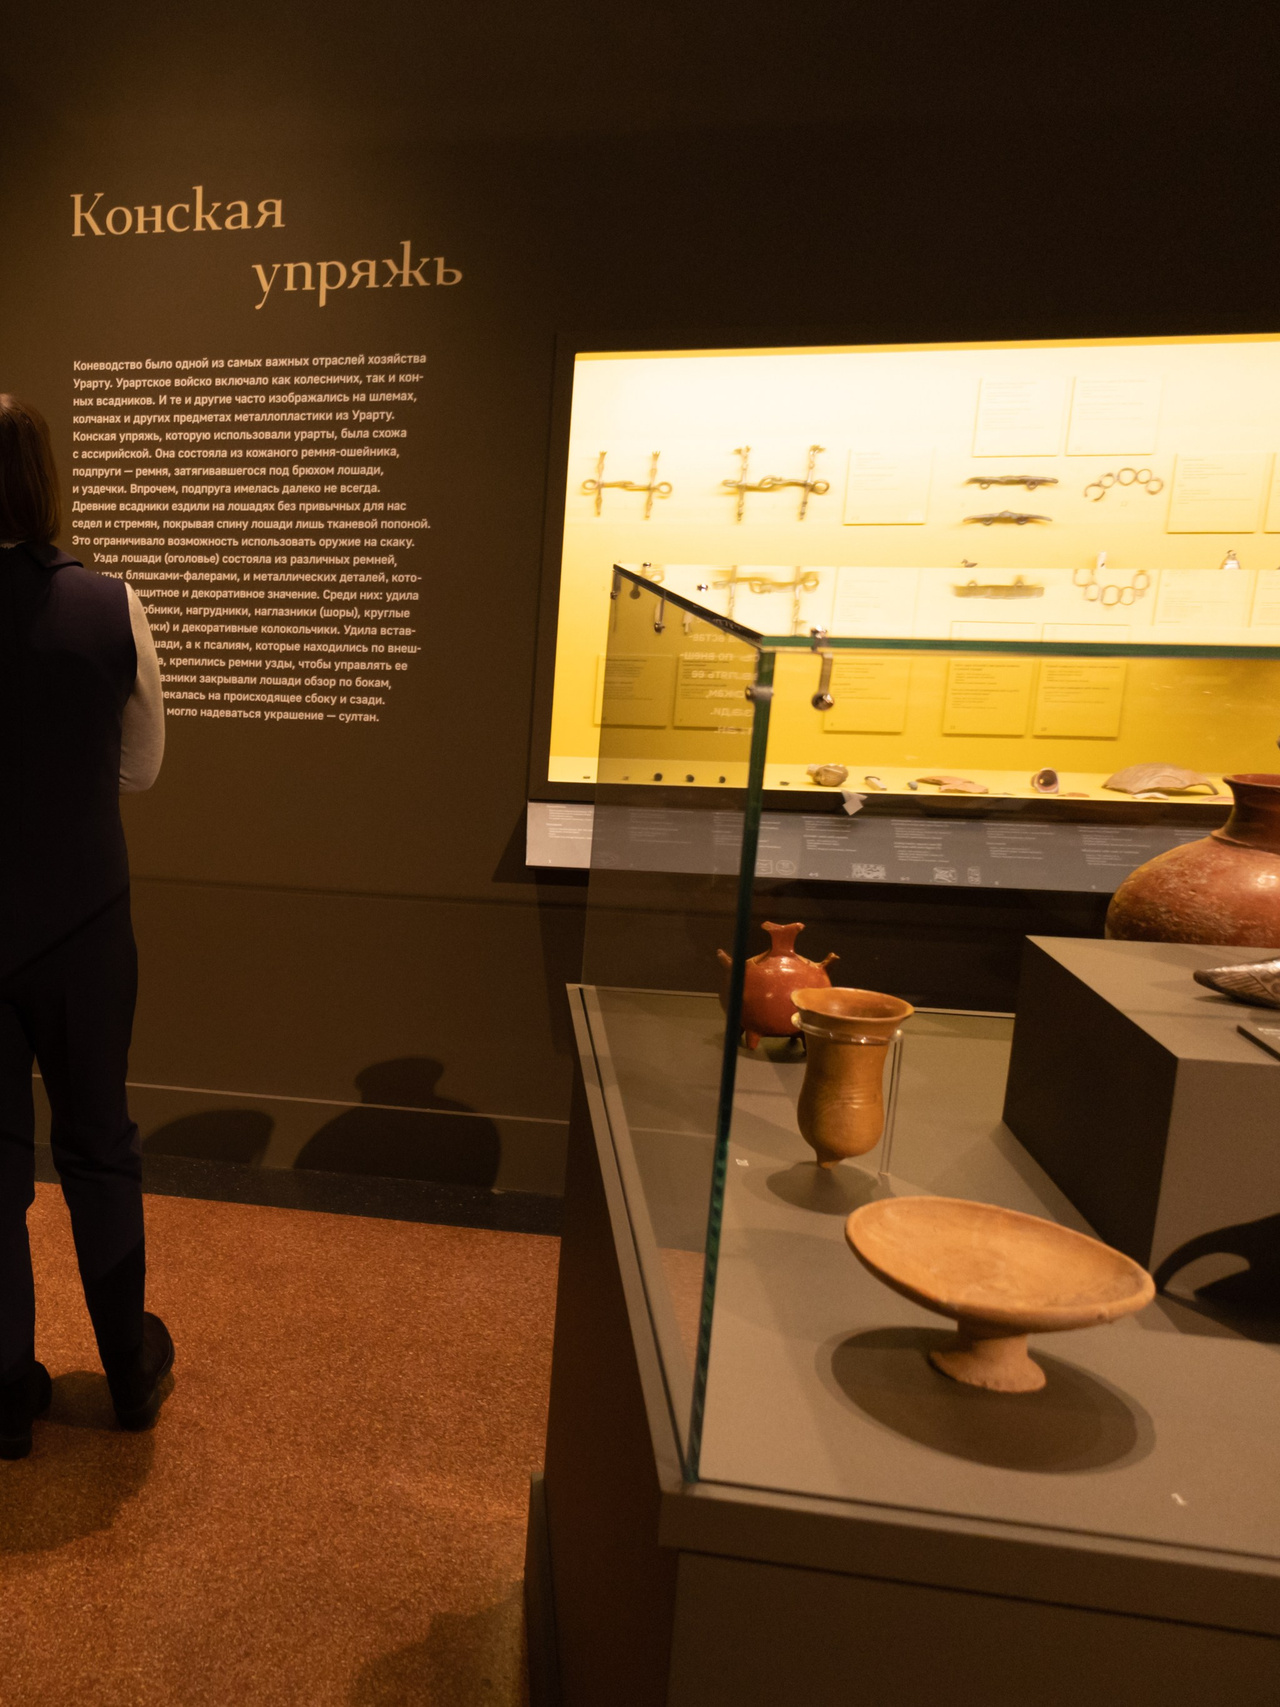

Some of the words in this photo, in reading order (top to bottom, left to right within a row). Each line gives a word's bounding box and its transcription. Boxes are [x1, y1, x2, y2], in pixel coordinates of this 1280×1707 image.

[69, 185, 286, 237] Конская
[251, 240, 463, 310] упряжь
[73, 360, 143, 371] Коневодство
[144, 358, 173, 369] было
[174, 357, 209, 370] одной
[211, 359, 225, 368] из
[226, 358, 262, 368] самых
[265, 357, 310, 367] важных
[312, 354, 365, 368] отраслей
[367, 353, 426, 364] хозяйства
[72, 378, 113, 391] Урарту.
[115, 377, 172, 390] Урартское
[174, 375, 212, 387] войско
[214, 376, 269, 386] включало
[271, 376, 291, 385] как
[293, 375, 362, 385] колесничих,
[365, 374, 385, 383] так
[388, 374, 396, 382] и
[398, 373, 424, 382] кон-
[72, 397, 94, 406] ных
[96, 396, 156, 407] всадников.
[158, 394, 167, 405] И
[169, 396, 182, 405] те
[184, 396, 192, 404] и
[193, 395, 232, 407] другие
[234, 394, 266, 404] часто
[268, 391, 350, 405] изображались
[352, 393, 366, 402] на
[368, 392, 417, 402] шлемах,
[72, 415, 121, 424] колчанах
[123, 414, 131, 423] и
[132, 414, 170, 425] других
[173, 413, 232, 425] предметах
[234, 412, 333, 422] металлопластики
[335, 411, 349, 420] из
[352, 409, 394, 422] Урарту.
[72, 431, 117, 441] Конская
[118, 432, 162, 443] упряжь,
[165, 431, 211, 443] которую
[213, 430, 291, 440] использовали
[293, 430, 338, 442] урарты,
[340, 427, 370, 439] была
[372, 429, 407, 438] схожа
[72, 450, 79, 459] с
[80, 448, 152, 461] ассирийской.
[154, 447, 176, 459] Она
[177, 449, 228, 458] состояла
[230, 449, 243, 458] из
[245, 448, 298, 458] кожаного
[300, 446, 400, 459] ремня-ошейника,
[72, 467, 122, 479] подпруги
[135, 467, 171, 478] ремня,
[173, 467, 266, 476] затягивавшегося
[268, 466, 290, 477] под
[292, 464, 334, 477] брюхом
[336, 466, 384, 476] лошади,
[72, 485, 79, 494] и
[81, 485, 127, 496] уздечки.
[130, 483, 178, 496] Впрочем,
[181, 485, 231, 496] подпруга
[233, 485, 280, 493] имелась
[281, 484, 321, 495] далеко
[323, 484, 338, 493] не
[340, 484, 380, 494] всегда.
[71, 500, 117, 513] Древние
[118, 502, 169, 512] всадники
[171, 502, 210, 513] ездили
[212, 502, 225, 511] на
[226, 502, 275, 512] лошадях
[277, 500, 296, 511] без
[298, 502, 360, 513] привычных
[362, 502, 384, 512] для
[386, 502, 406, 511] нас
[71, 519, 102, 529] седел
[104, 520, 112, 528] и
[113, 520, 160, 531] стремян,
[162, 520, 214, 531] покрывая
[216, 520, 249, 531] спину
[250, 520, 293, 530] лошади
[294, 520, 325, 529] лишь
[326, 518, 378, 529] тканевой
[380, 518, 430, 529] попоной.
[71, 534, 91, 545] Это
[92, 537, 165, 548] ограничивало
[167, 537, 239, 546] возможность
[241, 538, 316, 547] использовать
[318, 538, 361, 549] оружие
[363, 538, 377, 547] на
[379, 538, 415, 549] скаку.
[92, 552, 118, 564] Узда
[120, 554, 162, 564] лошади
[164, 552, 220, 565] (оголовье)
[221, 555, 272, 564] состояла
[274, 555, 288, 564] из
[290, 555, 350, 566] различных
[352, 554, 397, 567] ремней,
[125, 569, 240, 583] бляшками-фалерами,
[243, 572, 250, 581] и
[252, 573, 337, 582] металлических
[338, 572, 389, 583] деталей,
[391, 574, 422, 583] кото-
[133, 588, 180, 600] ащитное
[182, 589, 189, 598] и
[190, 589, 265, 600] декоративное
[266, 590, 320, 599] значение.
[322, 589, 357, 602] Среди
[359, 591, 383, 600] них:
[385, 592, 419, 602] удила
[142, 604, 183, 616] обники,
[185, 606, 251, 618] нагрудники,
[254, 607, 317, 617] наглазники
[319, 606, 360, 619] (шоры),
[364, 609, 410, 620] круглые
[172, 623, 180, 632] и
[181, 623, 258, 635] декоративные
[260, 625, 340, 634] колокольчики.
[343, 624, 377, 636] Удила
[380, 627, 416, 636] встав-
[154, 640, 183, 650] шади,
[185, 640, 192, 649] а
[194, 641, 201, 649] к
[203, 641, 252, 652] псалиям,
[255, 642, 301, 653] которые
[303, 643, 368, 653] находились
[371, 644, 385, 653] по
[387, 644, 421, 653] внеш-
[169, 657, 226, 668] крепились
[228, 658, 262, 669] ремни
[264, 659, 295, 670] узды,
[298, 658, 332, 669] чтобы
[333, 661, 392, 672] управлять
[394, 662, 408, 671] ее
[198, 675, 257, 686] закрывали
[258, 676, 302, 687] лошади
[304, 675, 336, 689] обзор
[338, 678, 352, 687] по
[354, 676, 392, 690] бокам,
[208, 692, 221, 700] на
[223, 692, 302, 704] происходящее
[304, 692, 337, 706] сбоку
[339, 695, 347, 704] и
[349, 695, 385, 706] сзади.
[166, 707, 198, 716] могло
[200, 708, 262, 719] надеваться
[263, 710, 324, 721] украшение
[338, 713, 379, 723] султан.
